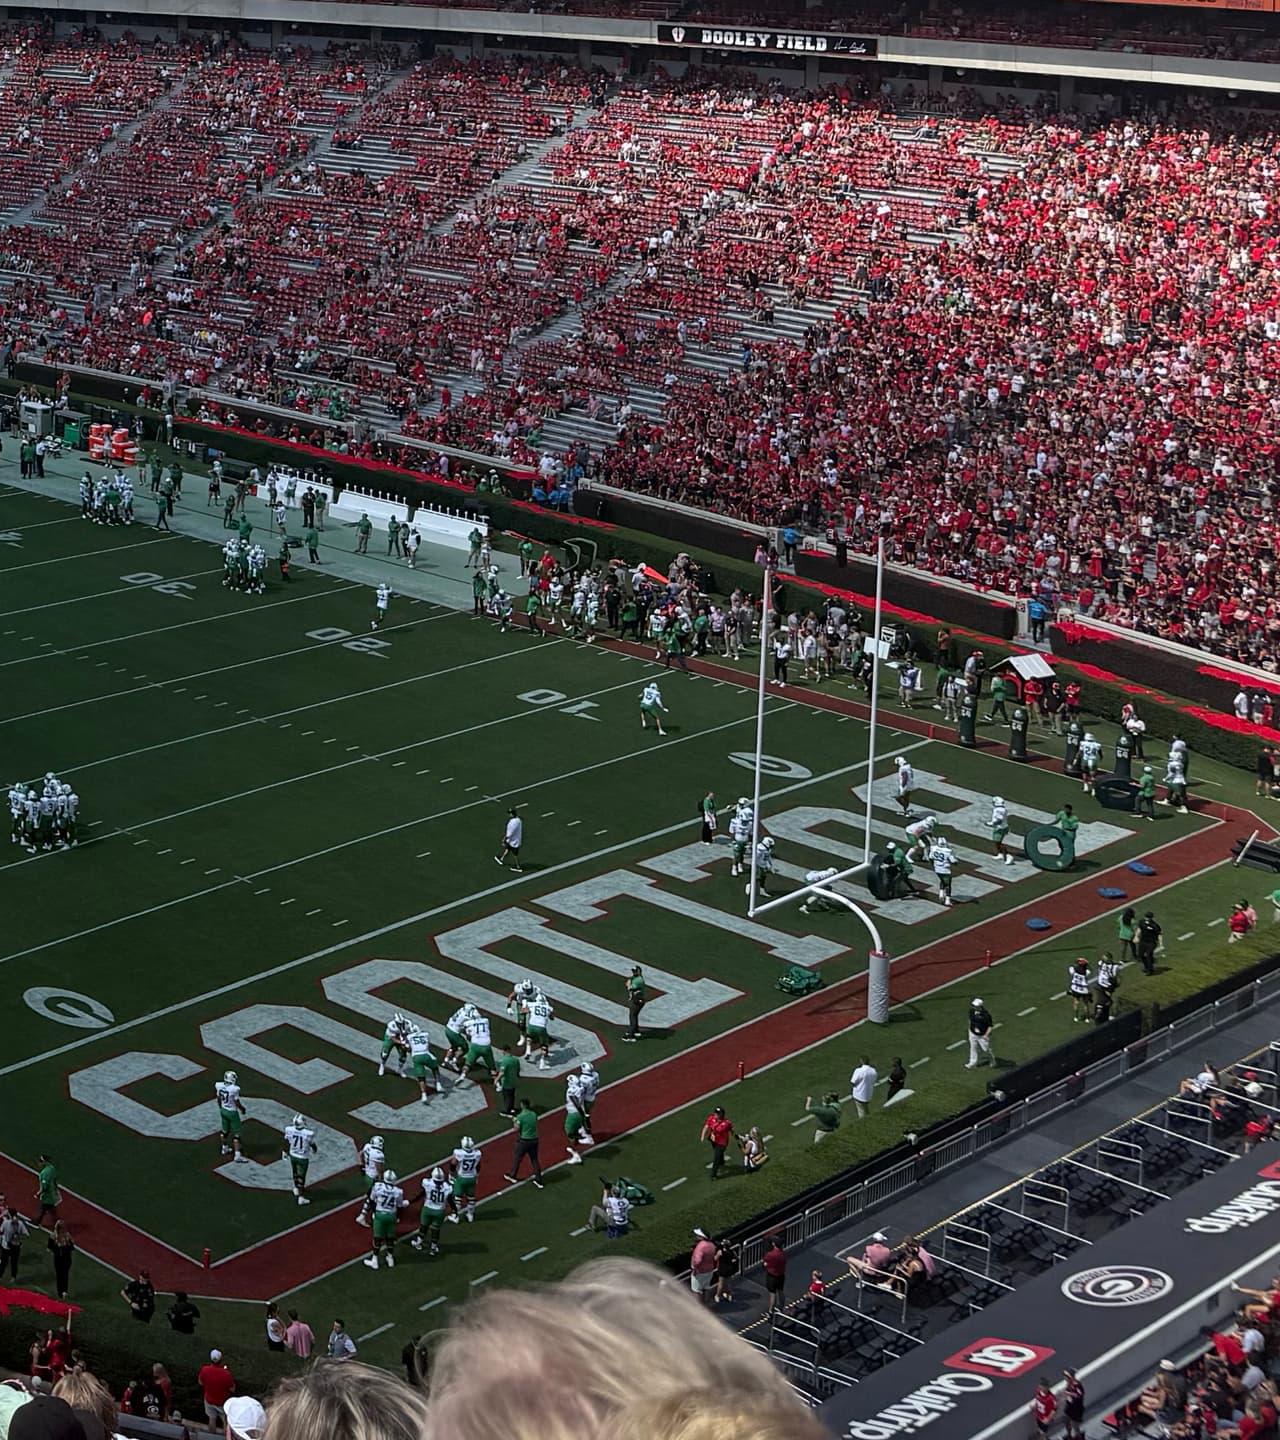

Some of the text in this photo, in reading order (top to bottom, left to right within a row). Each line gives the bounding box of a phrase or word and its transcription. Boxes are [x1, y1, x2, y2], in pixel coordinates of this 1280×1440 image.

[701, 29, 771, 48] DOOLEY
[776, 34, 827, 52] FIELD
[119, 572, 198, 595] 30
[304, 626, 392, 652] 20
[515, 688, 601, 714] 10
[68, 767, 1137, 1192] BULLDOGS
[22, 986, 116, 1029] G
[292, 1136, 304, 1150] 71
[380, 1195, 396, 1209] 74
[968, 1344, 1037, 1373] QT
[848, 1372, 994, 1440] QuikTrip
